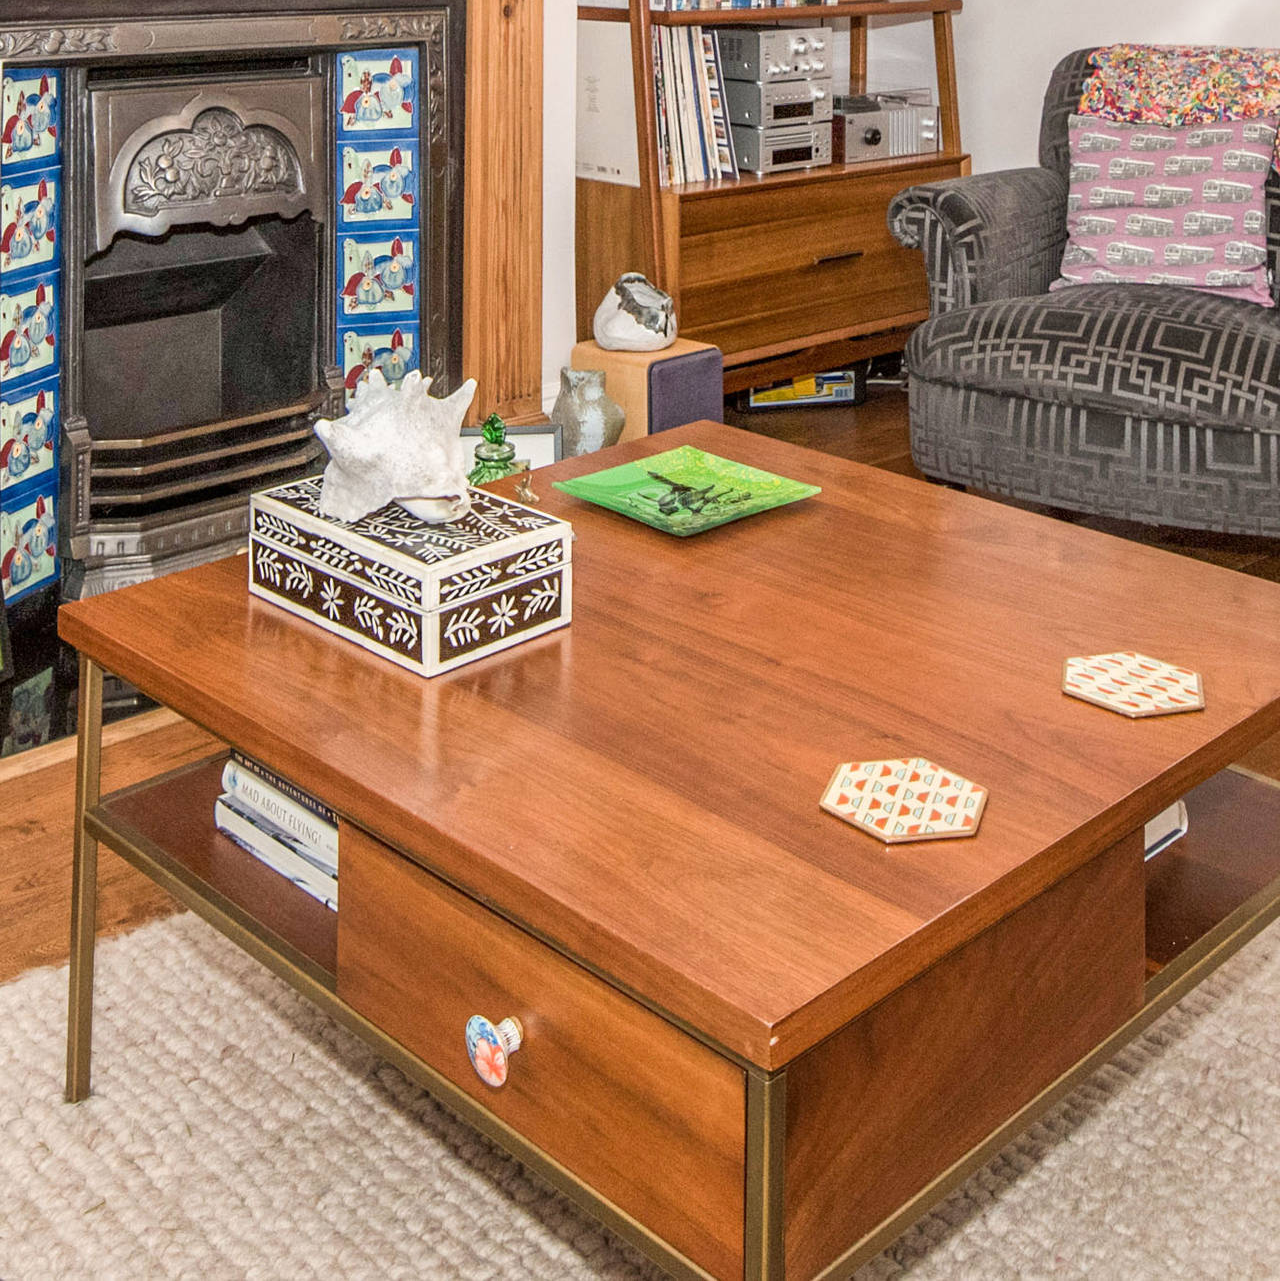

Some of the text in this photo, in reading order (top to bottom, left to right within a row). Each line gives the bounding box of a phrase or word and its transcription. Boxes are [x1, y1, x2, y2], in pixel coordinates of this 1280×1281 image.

[242, 782, 322, 844] MAD ABOUT FLYING!
